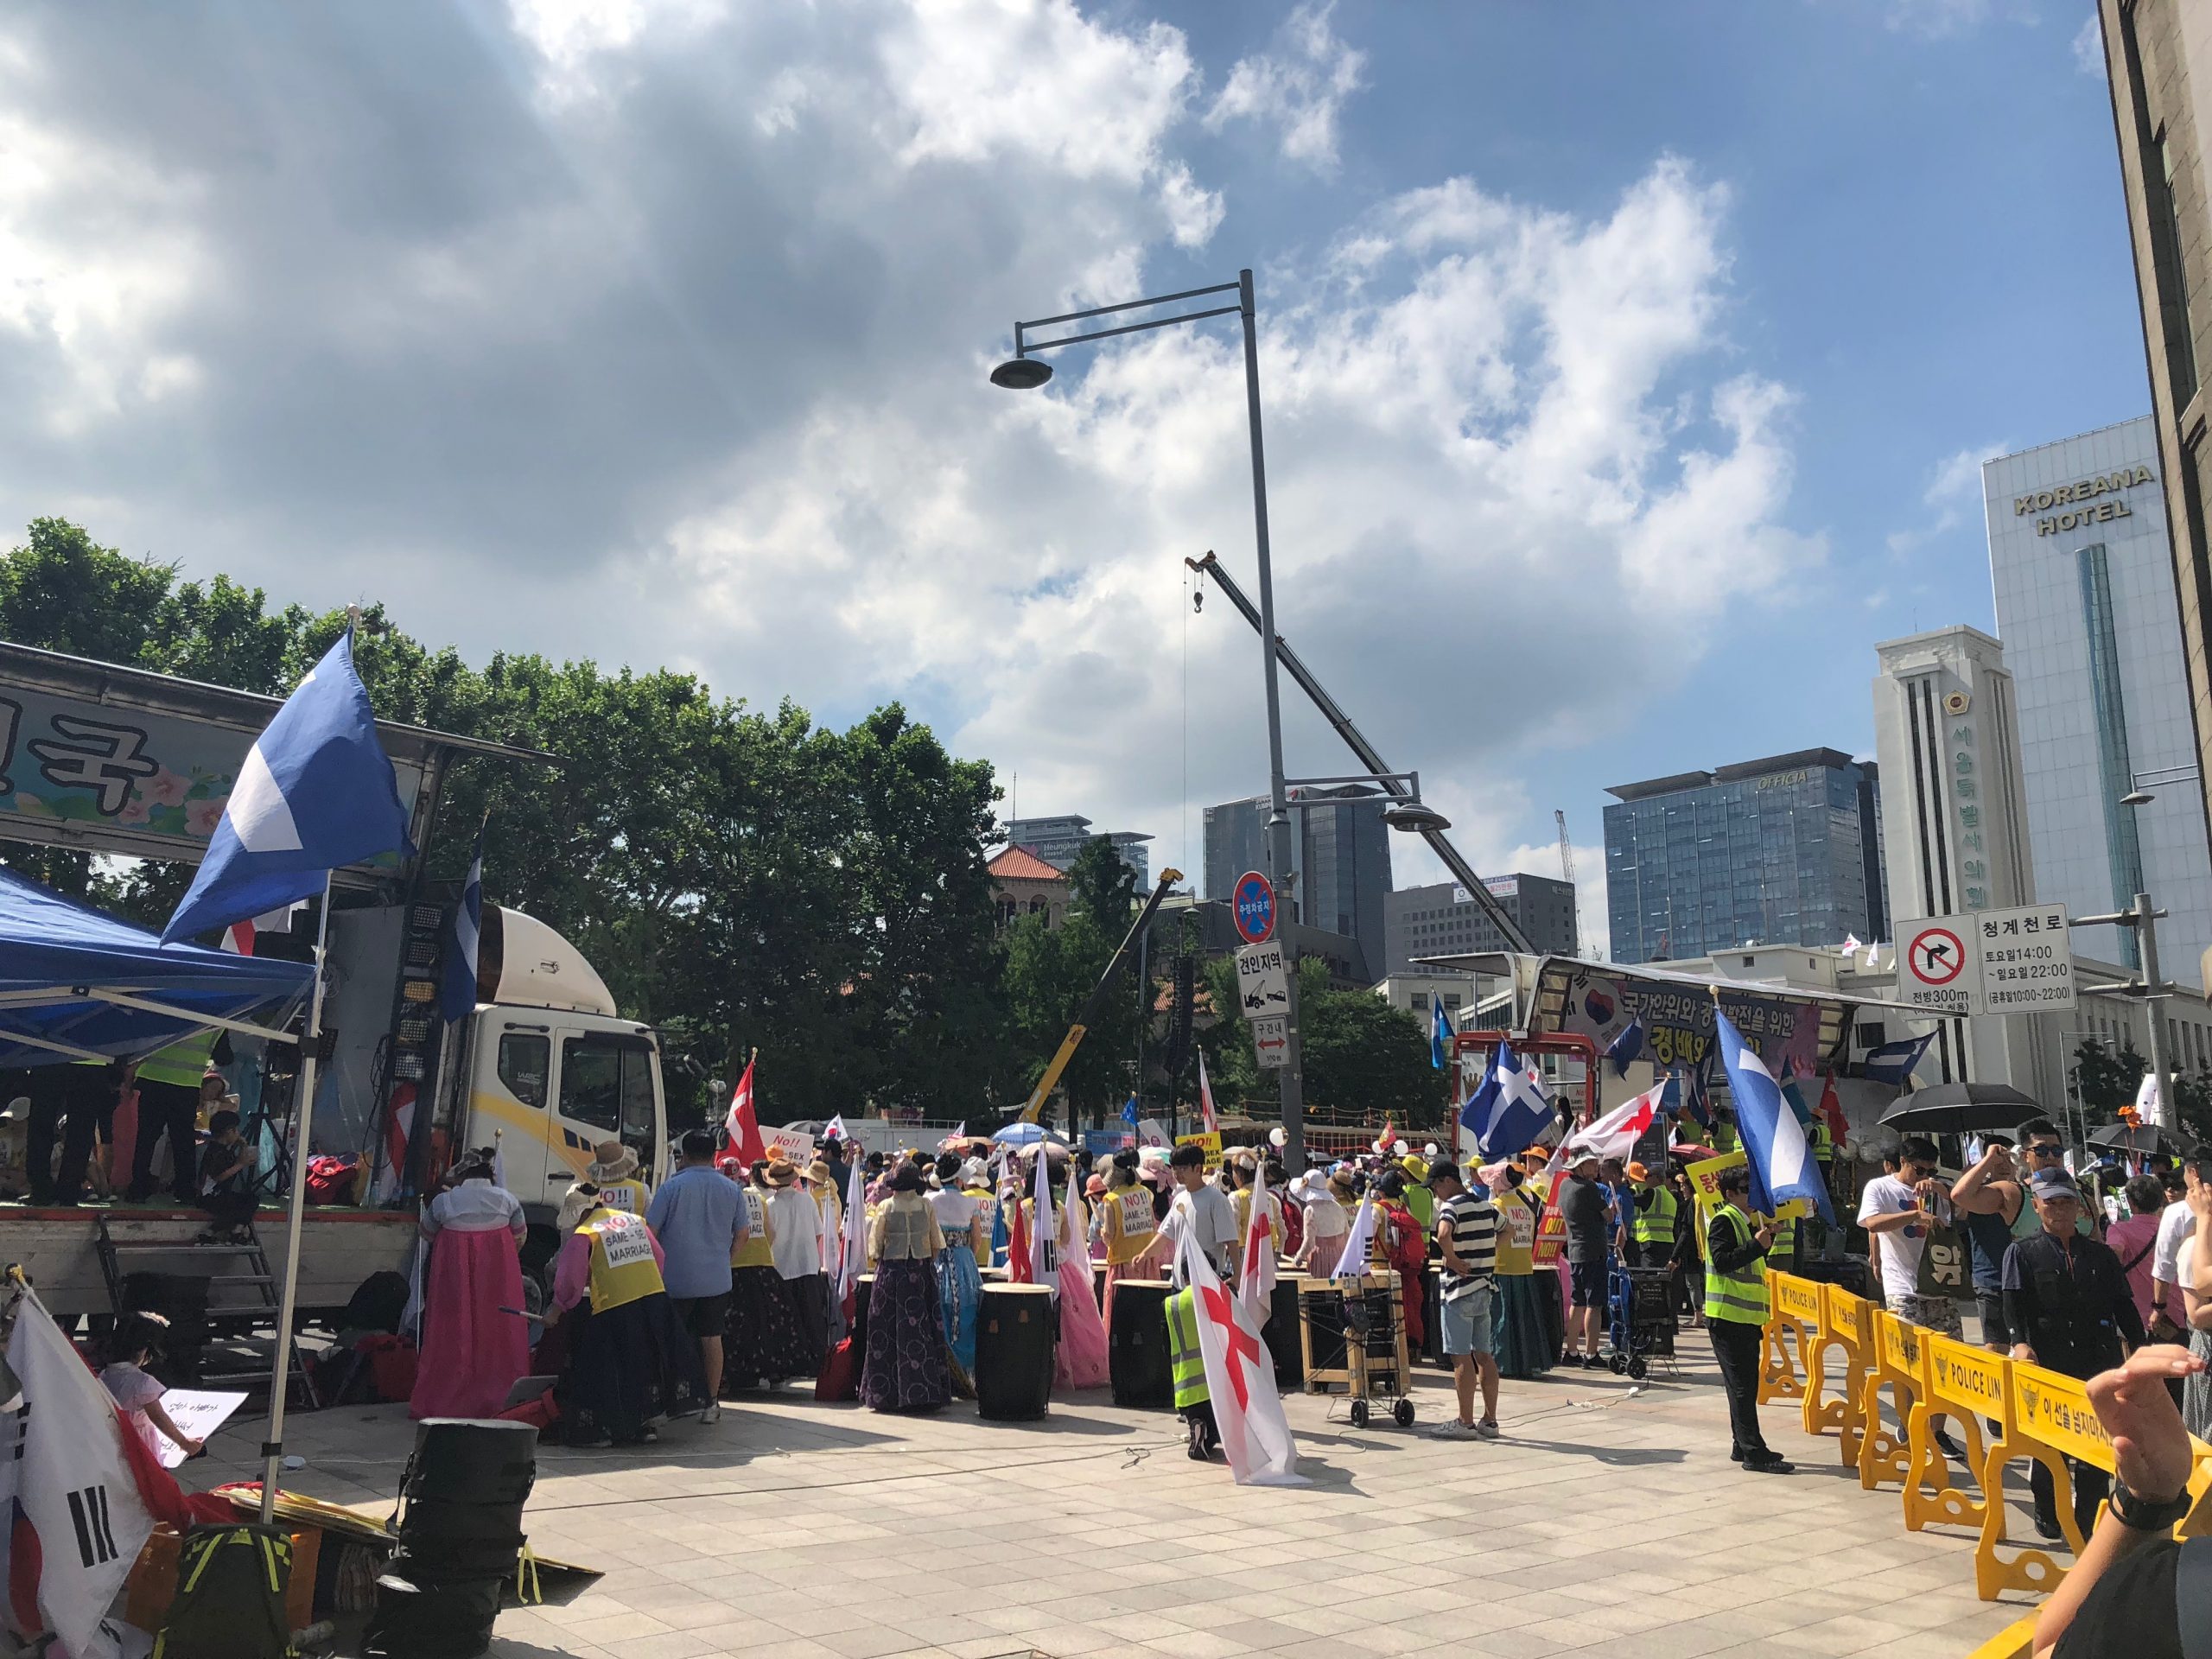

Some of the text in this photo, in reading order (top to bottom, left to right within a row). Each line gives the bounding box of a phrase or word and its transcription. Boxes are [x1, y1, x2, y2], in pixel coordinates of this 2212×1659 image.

[2014, 465, 2155, 516] KOREANA
[2037, 499, 2132, 537] HOTEL
[0, 696, 159, 817] 국
[1239, 951, 1282, 976] 견인지역
[1769, 1009, 1796, 1037] 위한
[773, 1135, 801, 1147] No!!
[1124, 1192, 1148, 1208] NO!!
[1544, 1217, 1563, 1234] OUT
[609, 1243, 652, 1262] MARRIAG
[1538, 1242, 1557, 1258] NO!!
[1789, 1288, 1817, 1310] POLICE LIN
[1951, 1363, 2001, 1402] POLICE LIN
[2044, 1397, 2113, 1447] 이 선을 넘지마시
